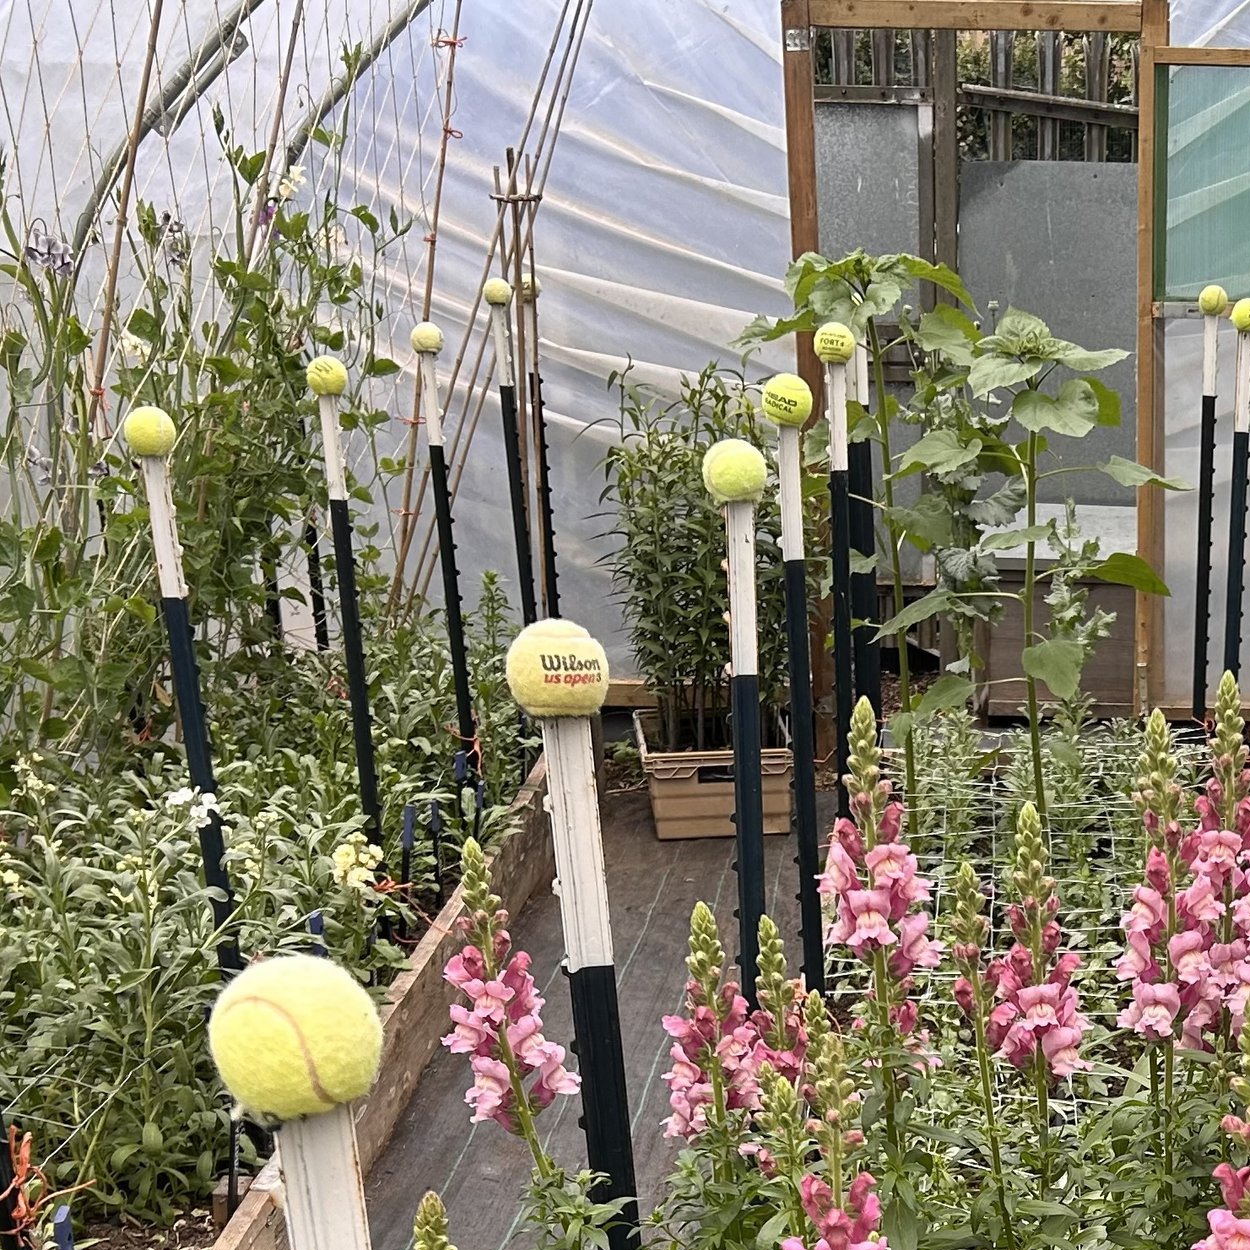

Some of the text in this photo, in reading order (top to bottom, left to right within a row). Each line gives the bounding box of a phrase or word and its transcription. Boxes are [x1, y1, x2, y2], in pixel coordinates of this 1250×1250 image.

[765, 397, 793, 414] RADICAL
[766, 391, 798, 407] HEAD
[539, 654, 601, 672] Wilson
[563, 673, 595, 688] open
